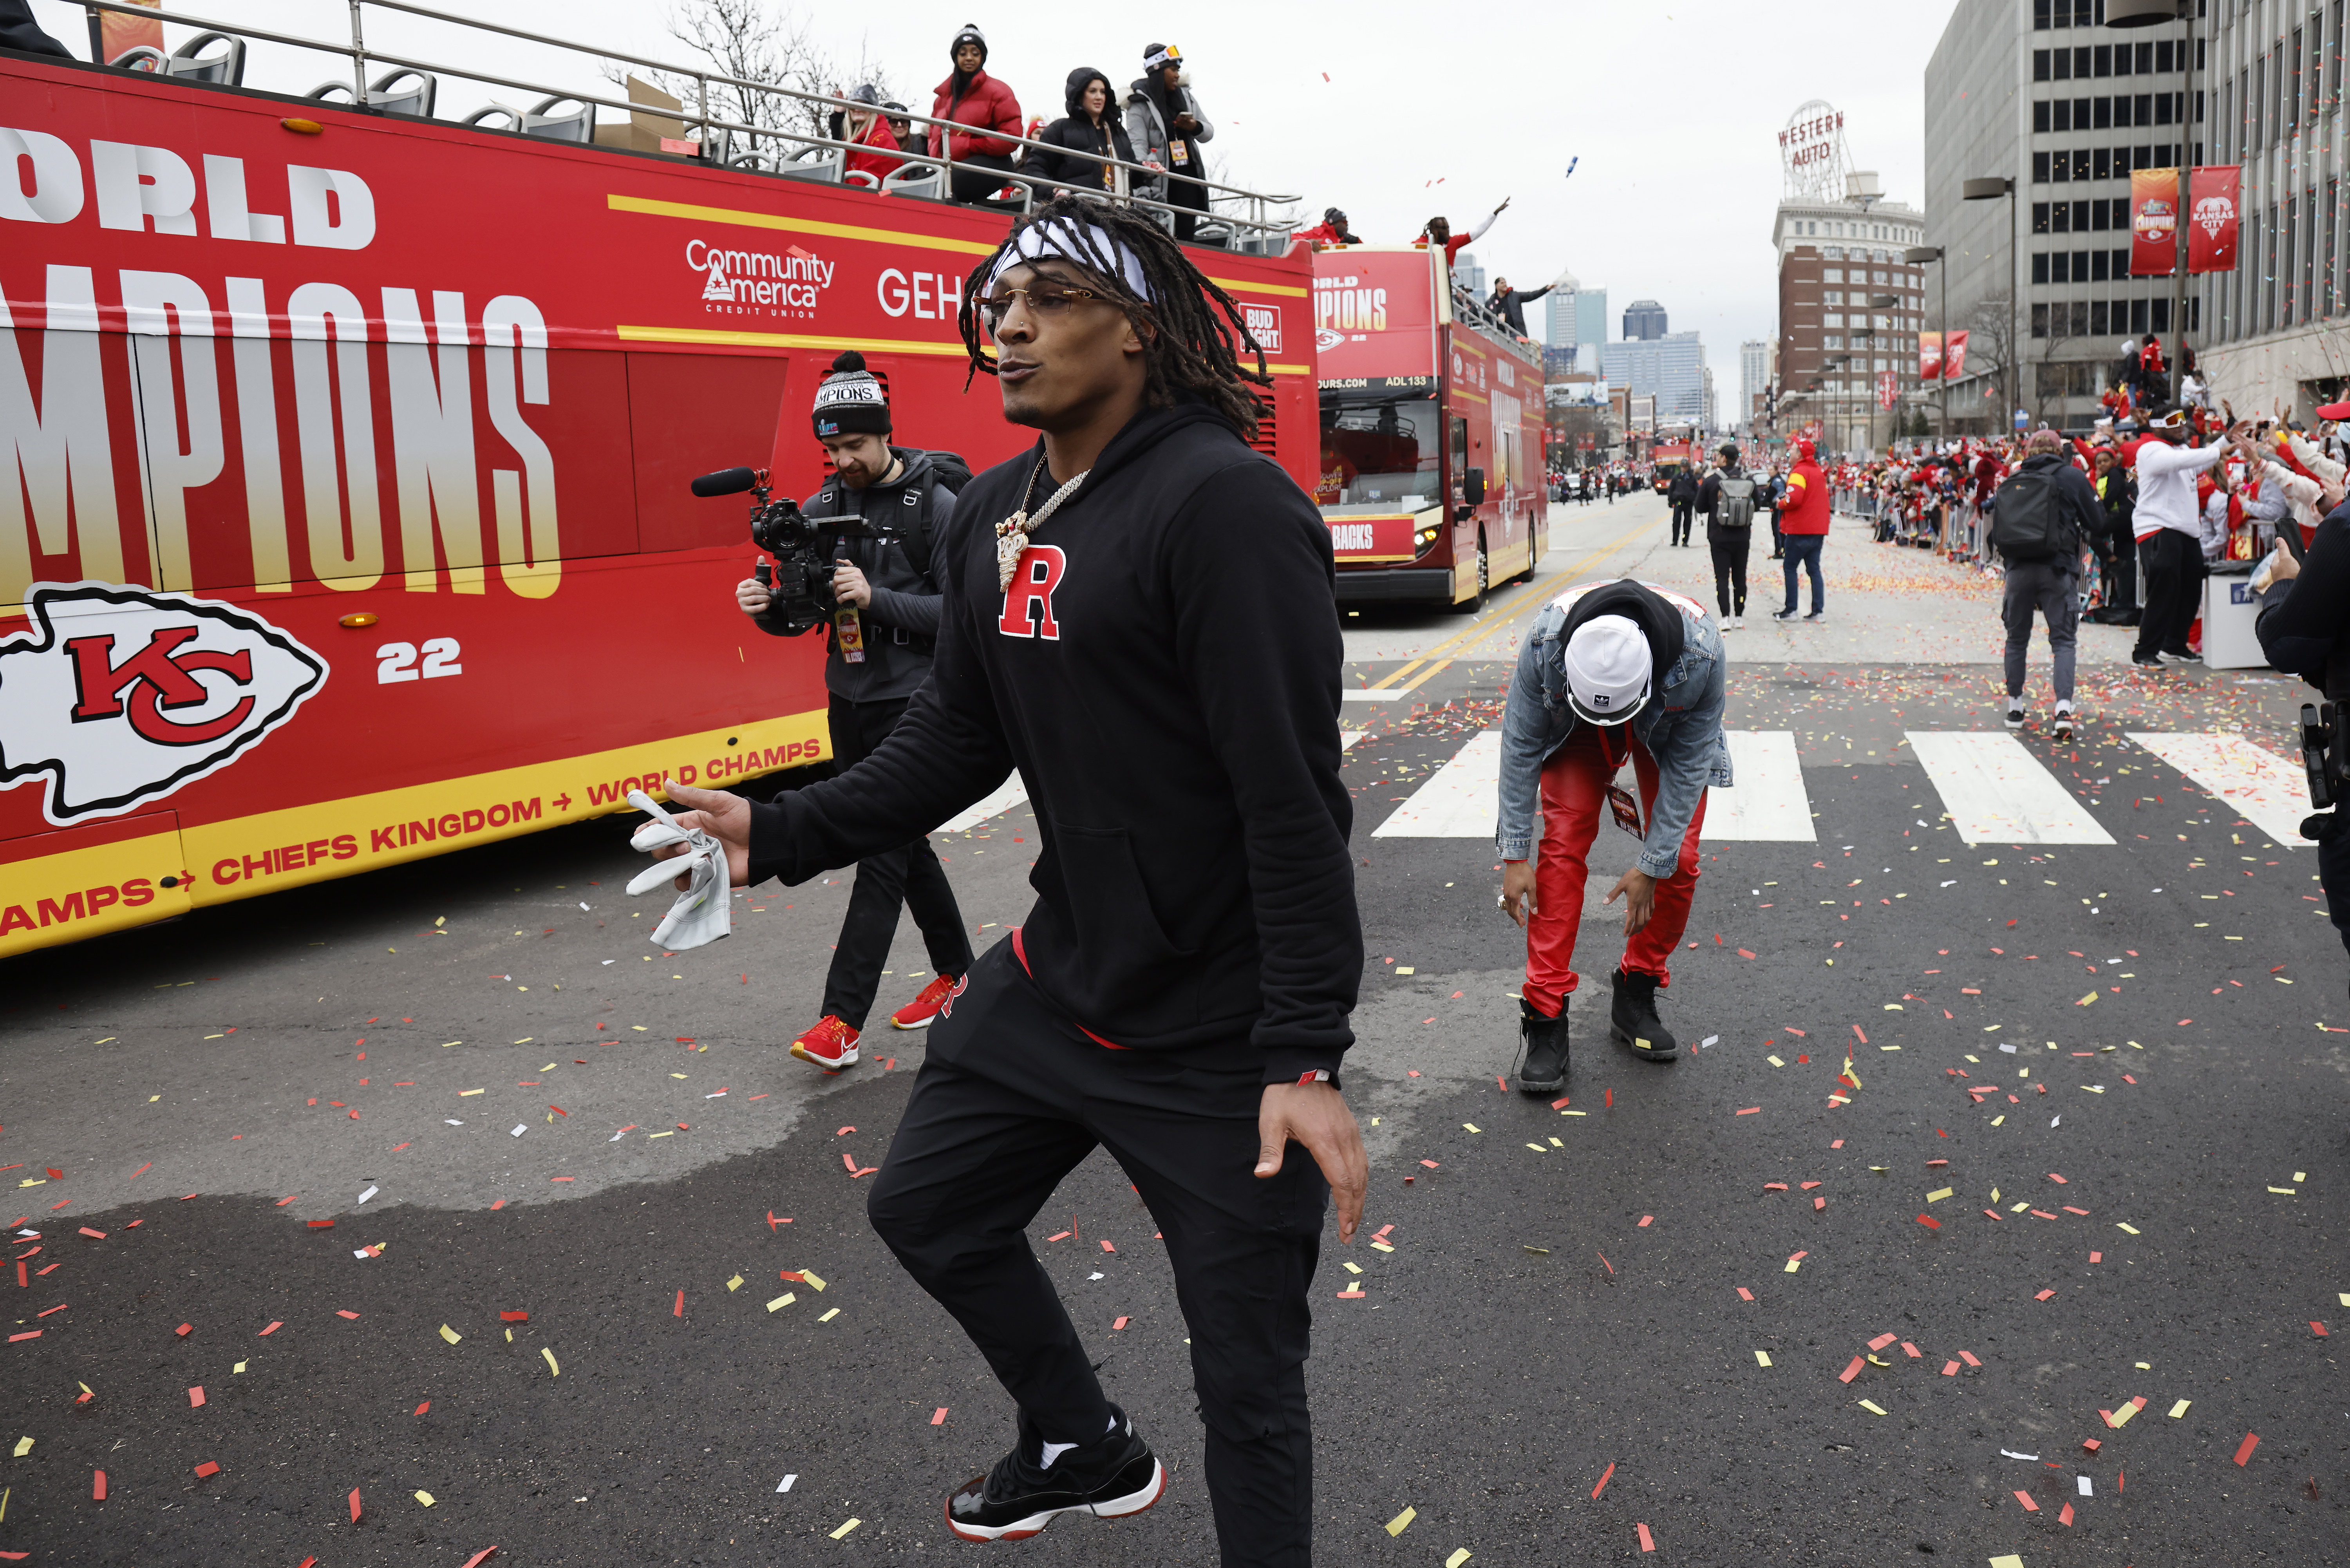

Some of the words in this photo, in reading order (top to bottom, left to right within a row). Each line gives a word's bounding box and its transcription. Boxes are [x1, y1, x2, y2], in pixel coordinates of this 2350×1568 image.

[1778, 111, 1843, 147] WESTERN
[1793, 142, 1830, 166] AUTO
[0, 127, 376, 251] ORLD
[2193, 210, 2234, 221] KANSAS
[2202, 219, 2225, 228] CITY
[686, 239, 835, 289] Community
[877, 268, 984, 320] GEH
[706, 304, 760, 315] CREDIT
[771, 309, 814, 318] UNION
[1246, 309, 1273, 329] BUD
[1243, 328, 1279, 348] GHT
[1385, 376, 1407, 386] ADL
[1408, 376, 1426, 385] 133
[996, 534, 1026, 561] POP
[1332, 524, 1373, 550] BACKS
[998, 544, 1067, 641] R
[376, 637, 462, 685] 22
[63, 625, 256, 747] KC
[0, 878, 154, 937] AMPS
[212, 835, 358, 885] CHIEFS
[371, 797, 542, 853] KINGDOM
[706, 739, 821, 779] CHAMPS
